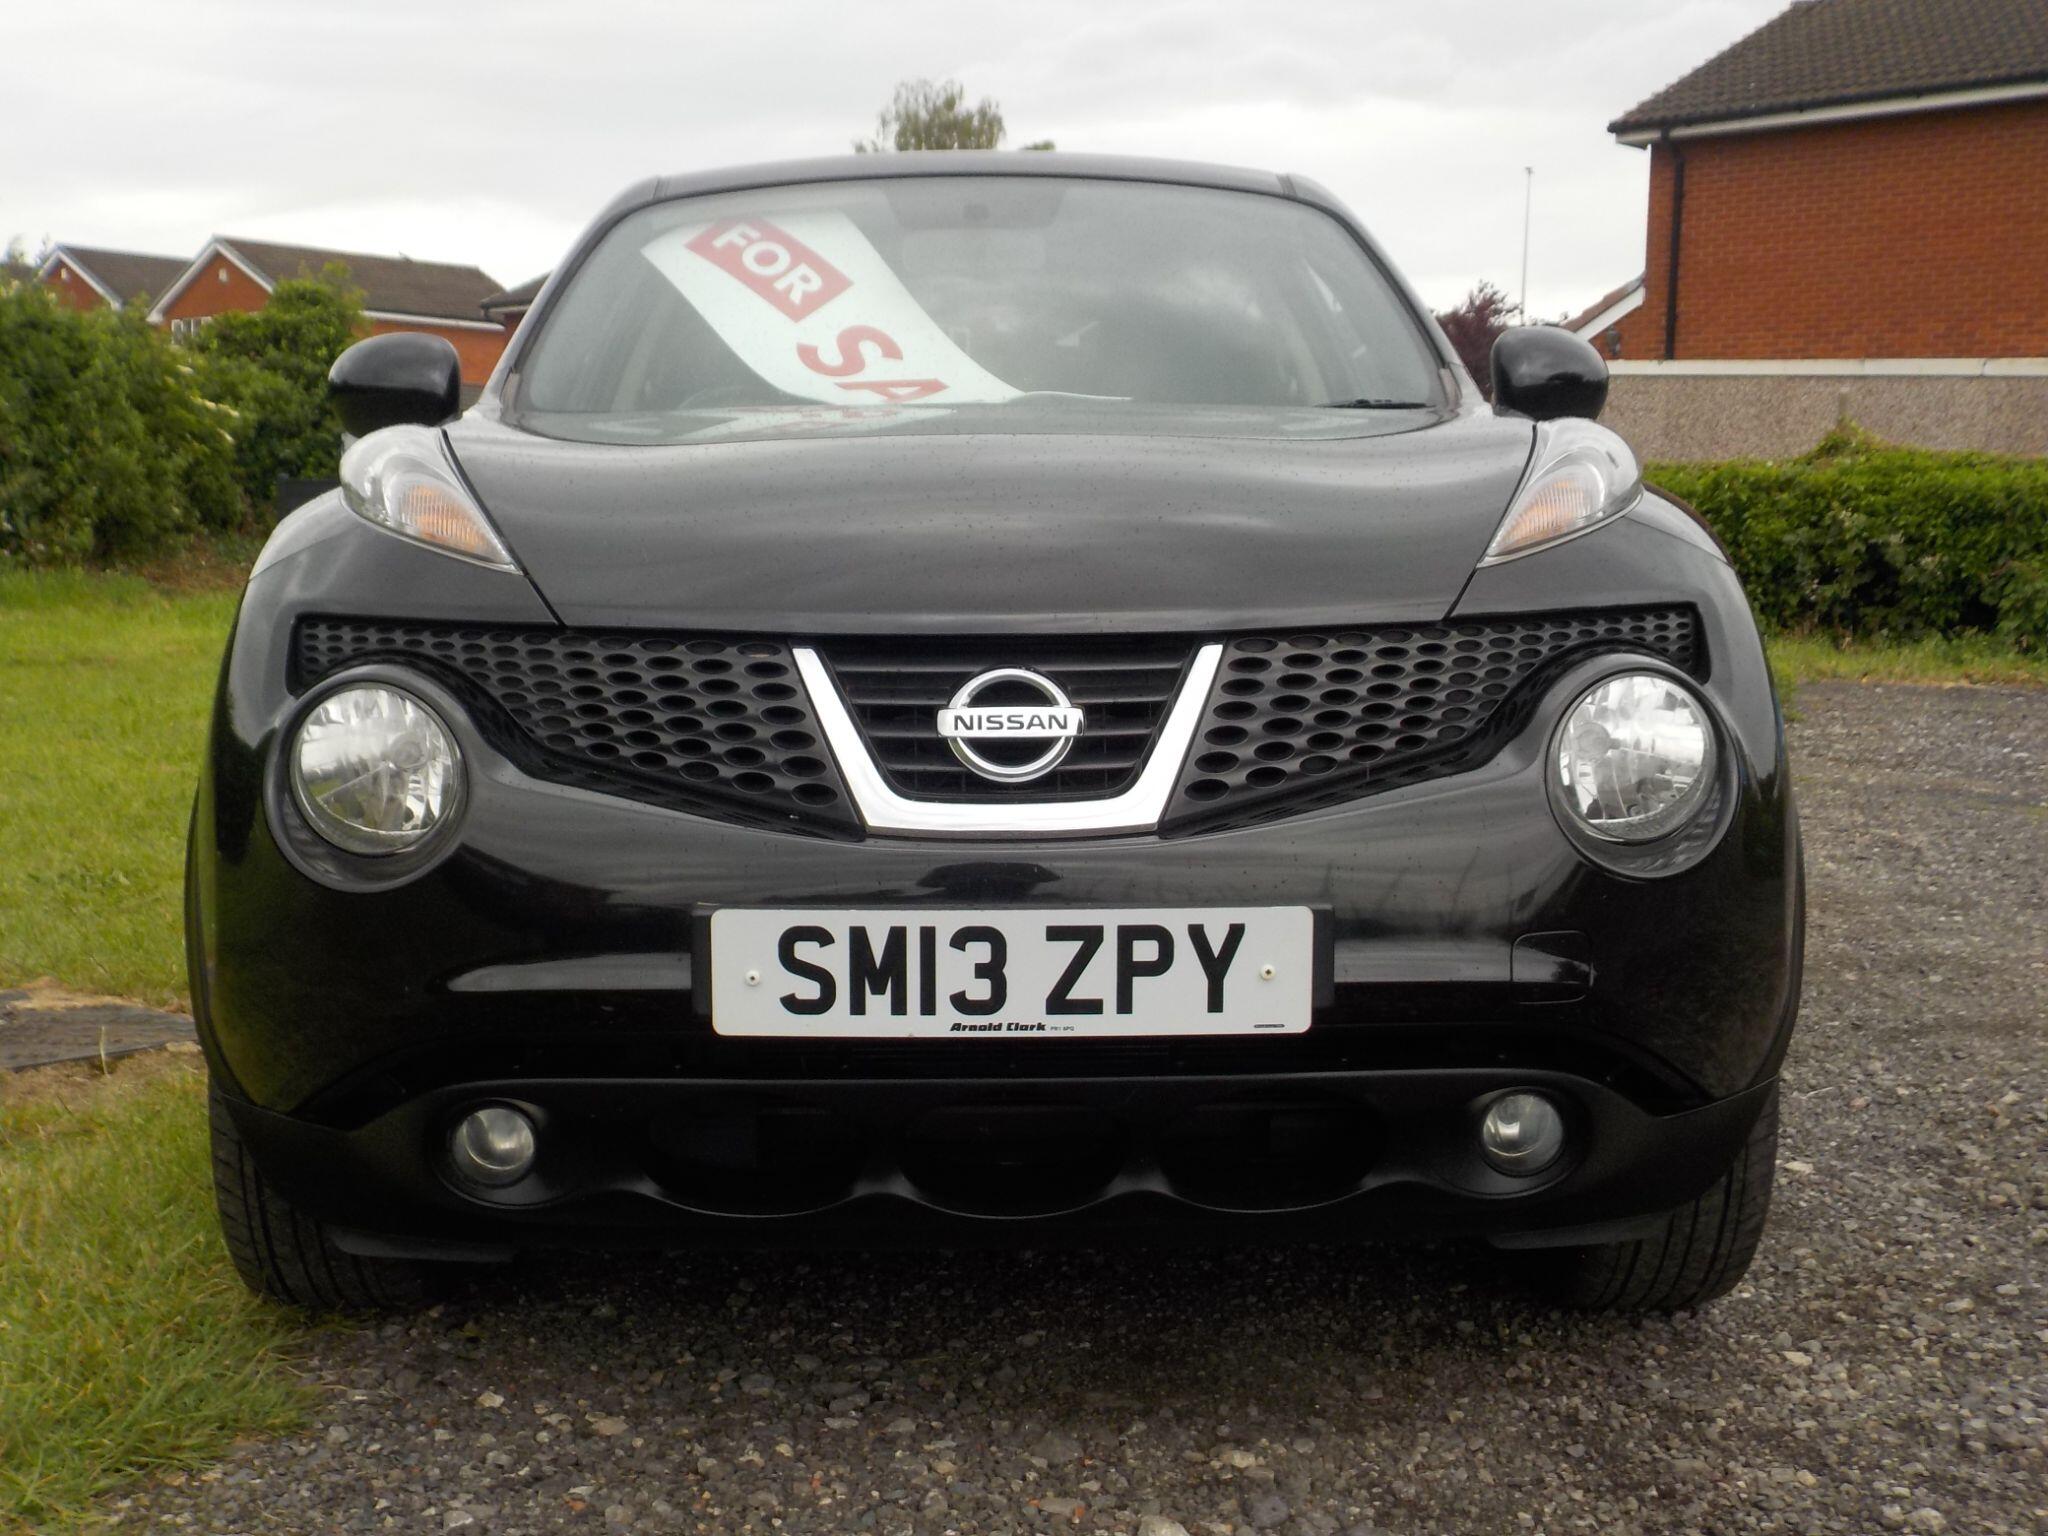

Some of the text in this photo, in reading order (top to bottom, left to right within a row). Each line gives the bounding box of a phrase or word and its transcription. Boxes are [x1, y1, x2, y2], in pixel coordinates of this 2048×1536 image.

[712, 223, 823, 304] FOR
[954, 715, 1068, 731] NISSAN
[778, 923, 1246, 1016] SM13 ZPY
[950, 1022, 1002, 1032] Arnold
[1006, 1022, 1046, 1032] Clark
